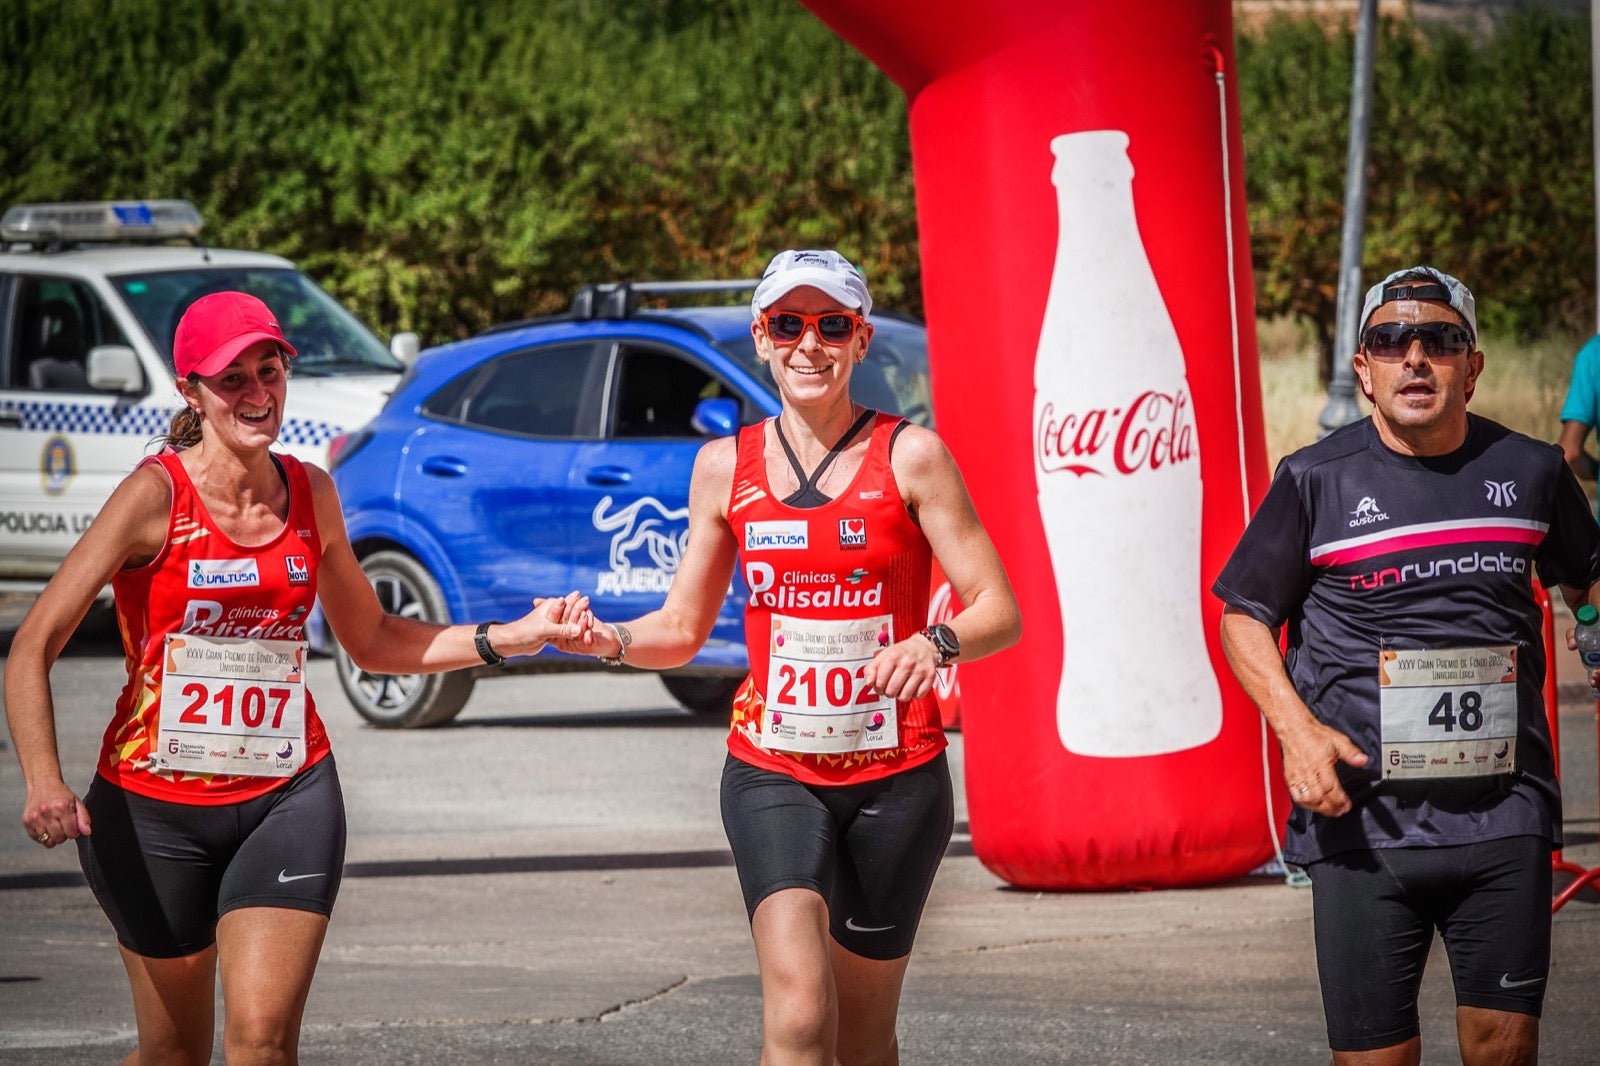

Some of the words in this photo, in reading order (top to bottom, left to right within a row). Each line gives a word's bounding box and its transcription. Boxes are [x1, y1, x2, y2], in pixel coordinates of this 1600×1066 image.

[840, 534, 865, 543] MOVE
[746, 562, 882, 609] Polisalud
[783, 571, 836, 584] Clínicas
[228, 606, 279, 620] Clínicas
[179, 683, 291, 728] 2107
[777, 664, 880, 707] 2102
[1428, 691, 1484, 732] 48
